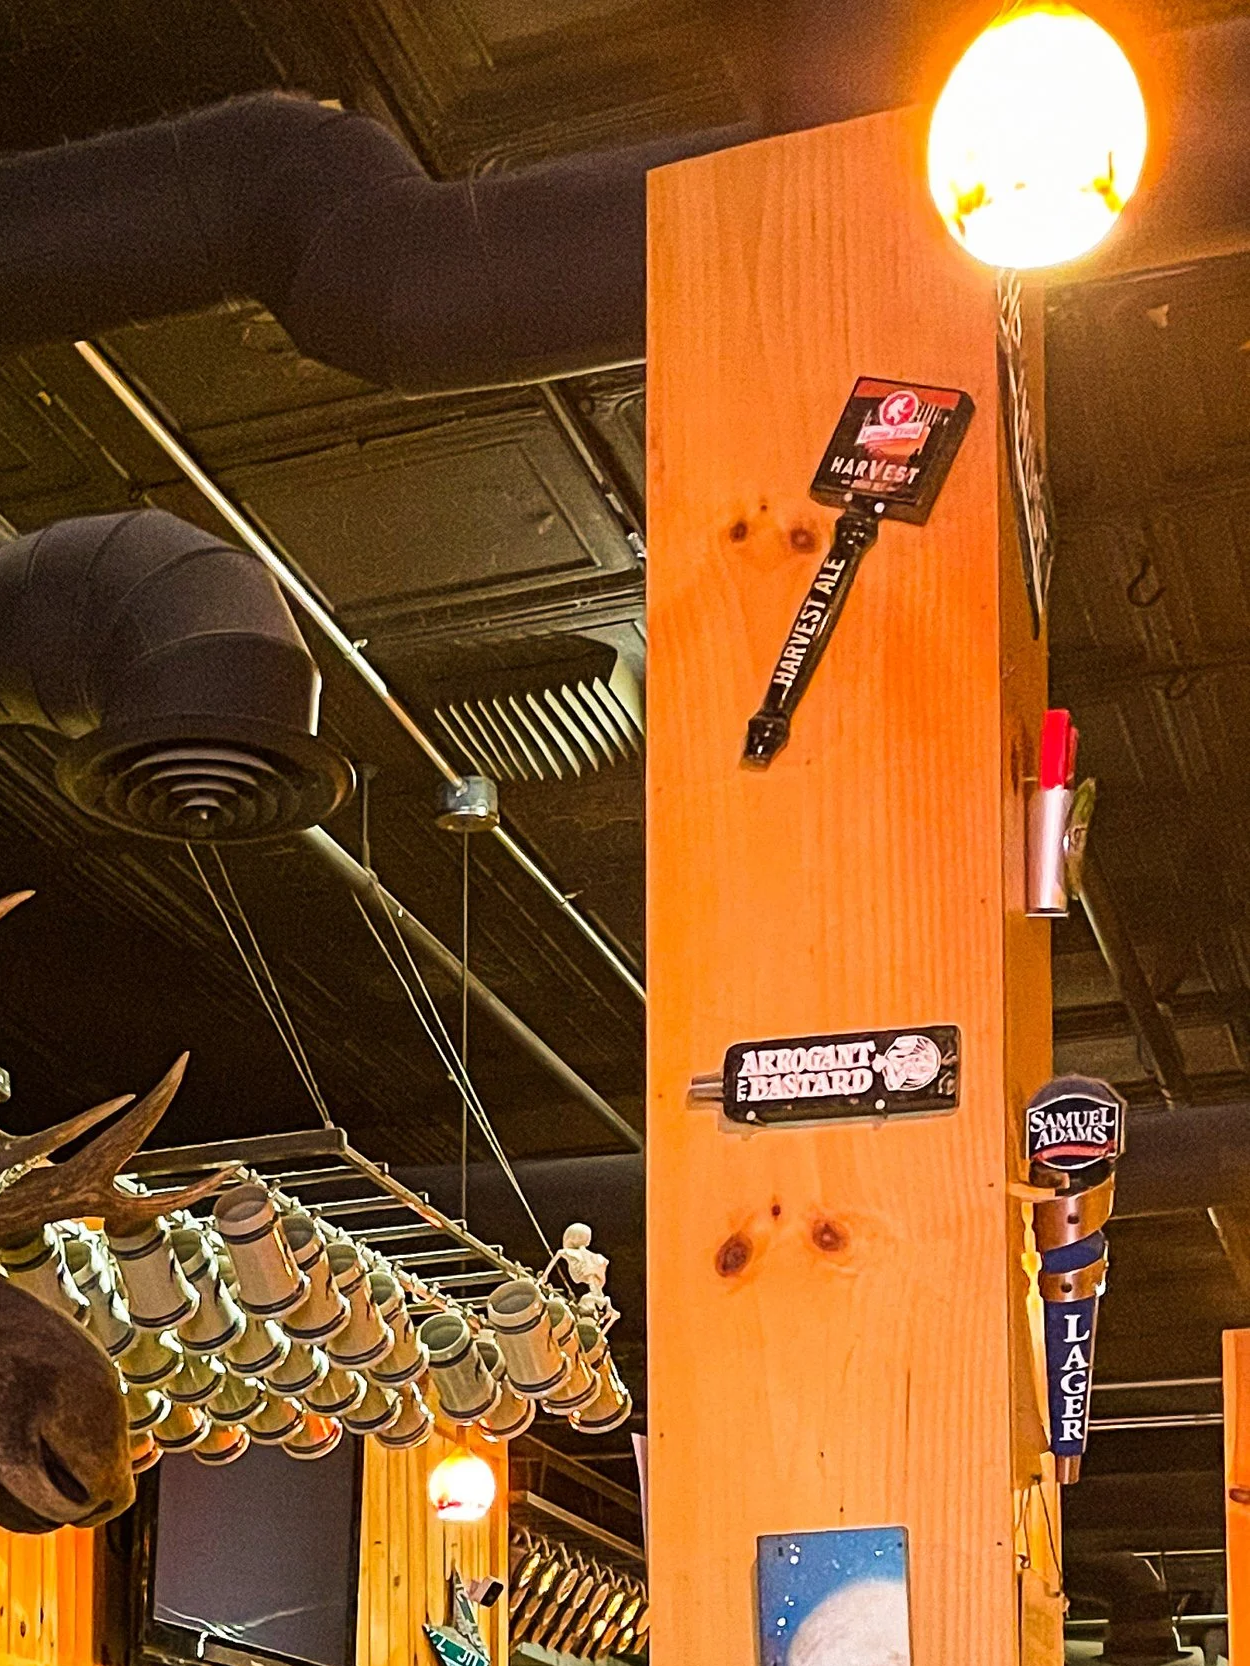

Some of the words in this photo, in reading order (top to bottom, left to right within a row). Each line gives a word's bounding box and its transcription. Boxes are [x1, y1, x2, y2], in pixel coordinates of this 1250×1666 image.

[830, 455, 920, 485] HARVEST
[772, 596, 826, 688] HARVEST
[814, 558, 846, 595] ALE
[737, 1040, 877, 1078] ARROGANT
[747, 1068, 874, 1101] BASTARD
[1029, 1107, 1115, 1133] SAMUEL
[1034, 1125, 1108, 1150] ADAMS
[1058, 1313, 1091, 1442] LAGER
